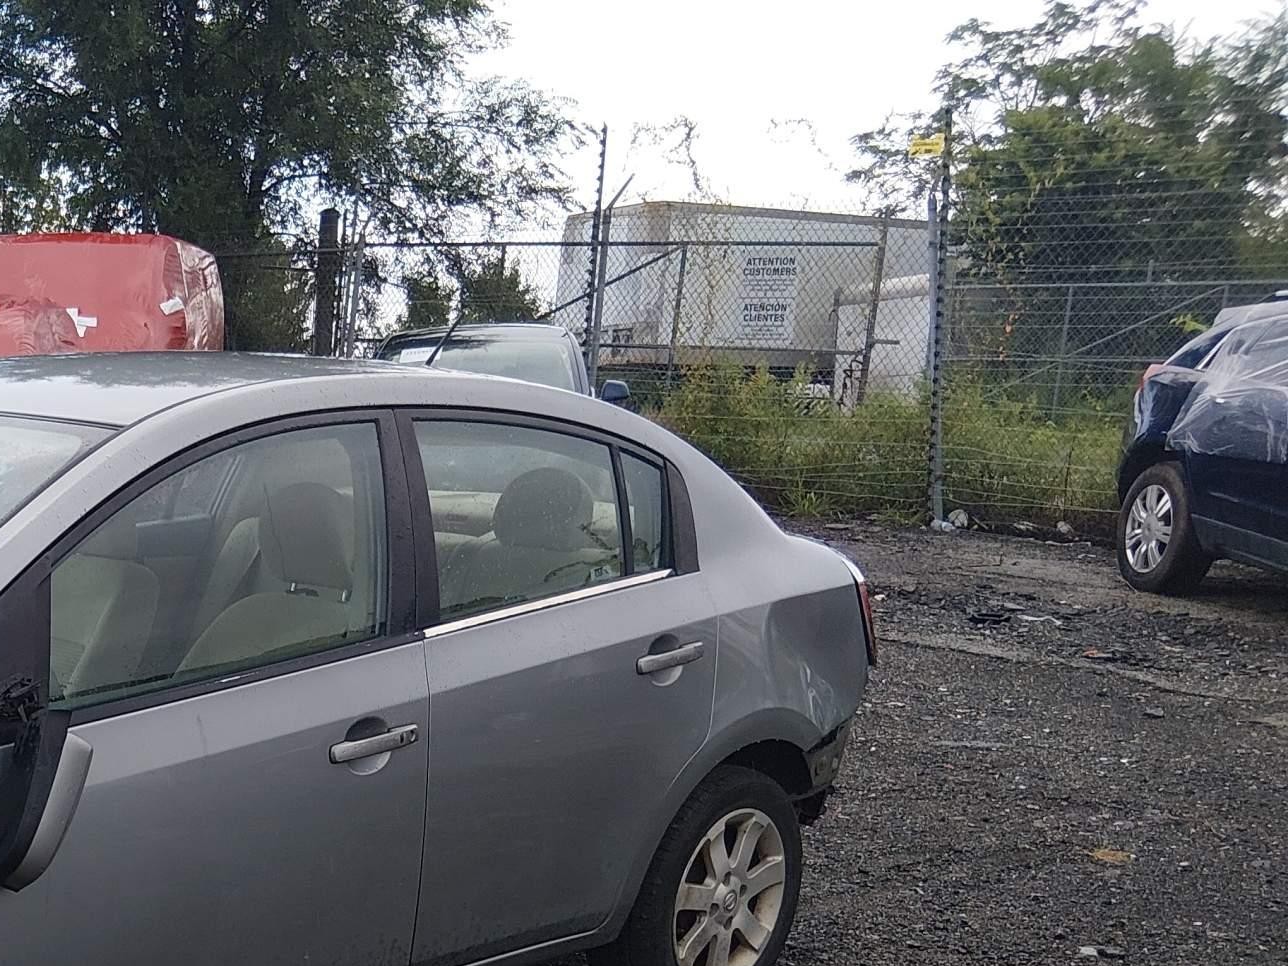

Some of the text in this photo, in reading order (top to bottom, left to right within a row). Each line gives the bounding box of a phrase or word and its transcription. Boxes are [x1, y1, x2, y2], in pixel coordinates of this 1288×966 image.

[746, 256, 796, 266] ATTENTION
[743, 267, 797, 277] CUSTOMERS
[743, 313, 785, 322] CLIENTES
